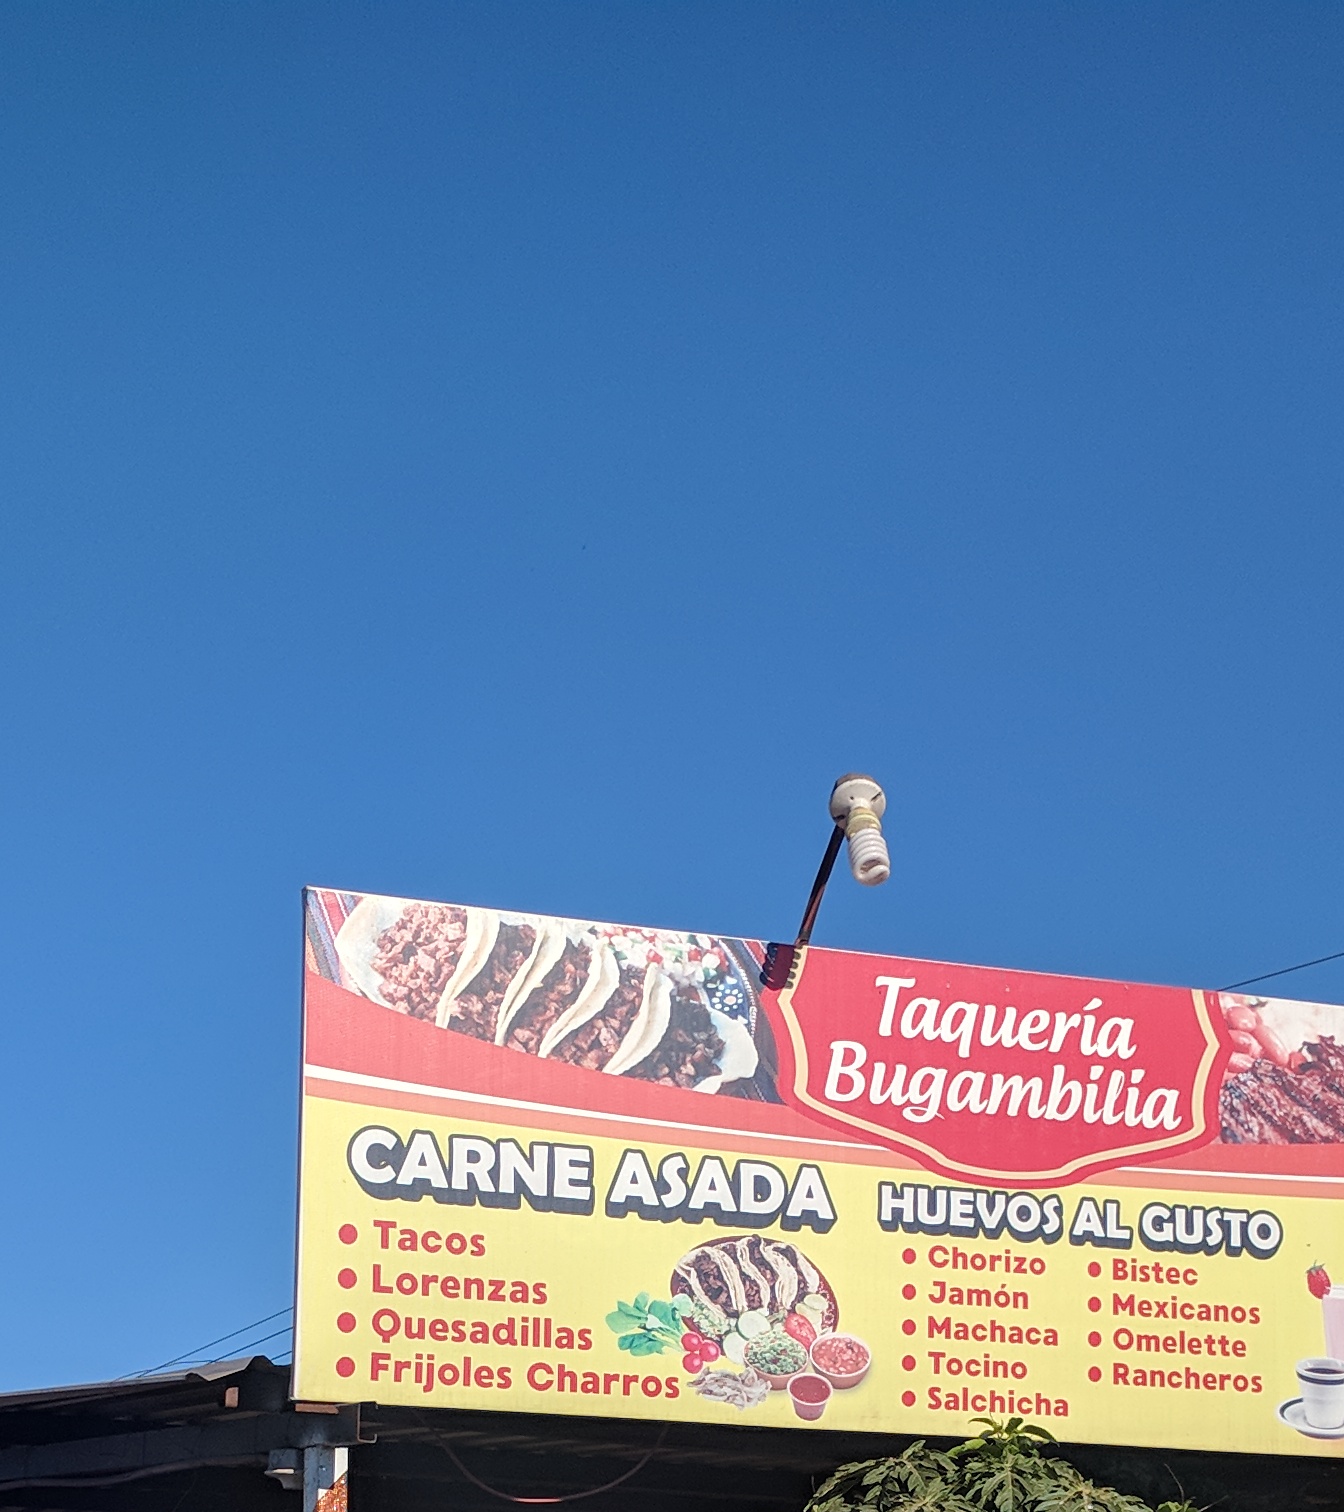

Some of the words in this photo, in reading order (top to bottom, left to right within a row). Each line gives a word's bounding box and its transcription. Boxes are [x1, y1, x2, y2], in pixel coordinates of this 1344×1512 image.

[875, 975, 1137, 1060] Taquería
[824, 1041, 1184, 1132] Bugambilia
[348, 1126, 593, 1213] CARNE
[607, 1149, 837, 1233] ASADA
[878, 1182, 1063, 1244] HUEVOS
[1070, 1196, 1133, 1250] AL
[1139, 1202, 1284, 1259] GUSTO
[372, 1219, 487, 1257] Tacos
[927, 1246, 1047, 1276] Chorizo
[1112, 1259, 1199, 1287] Bistec
[372, 1263, 548, 1304] Lorenzas
[927, 1280, 1029, 1310] Jamón
[1112, 1294, 1261, 1325] Mexicanos
[371, 1308, 594, 1351] Quesadillas
[927, 1317, 1059, 1347] Machaca
[1112, 1329, 1247, 1358] Omelette
[369, 1352, 517, 1393] Frijoles
[526, 1363, 680, 1399] Charros
[927, 1352, 1028, 1380] Tocino
[1112, 1363, 1264, 1393] Rancheros
[927, 1386, 1069, 1418] Salchicha
